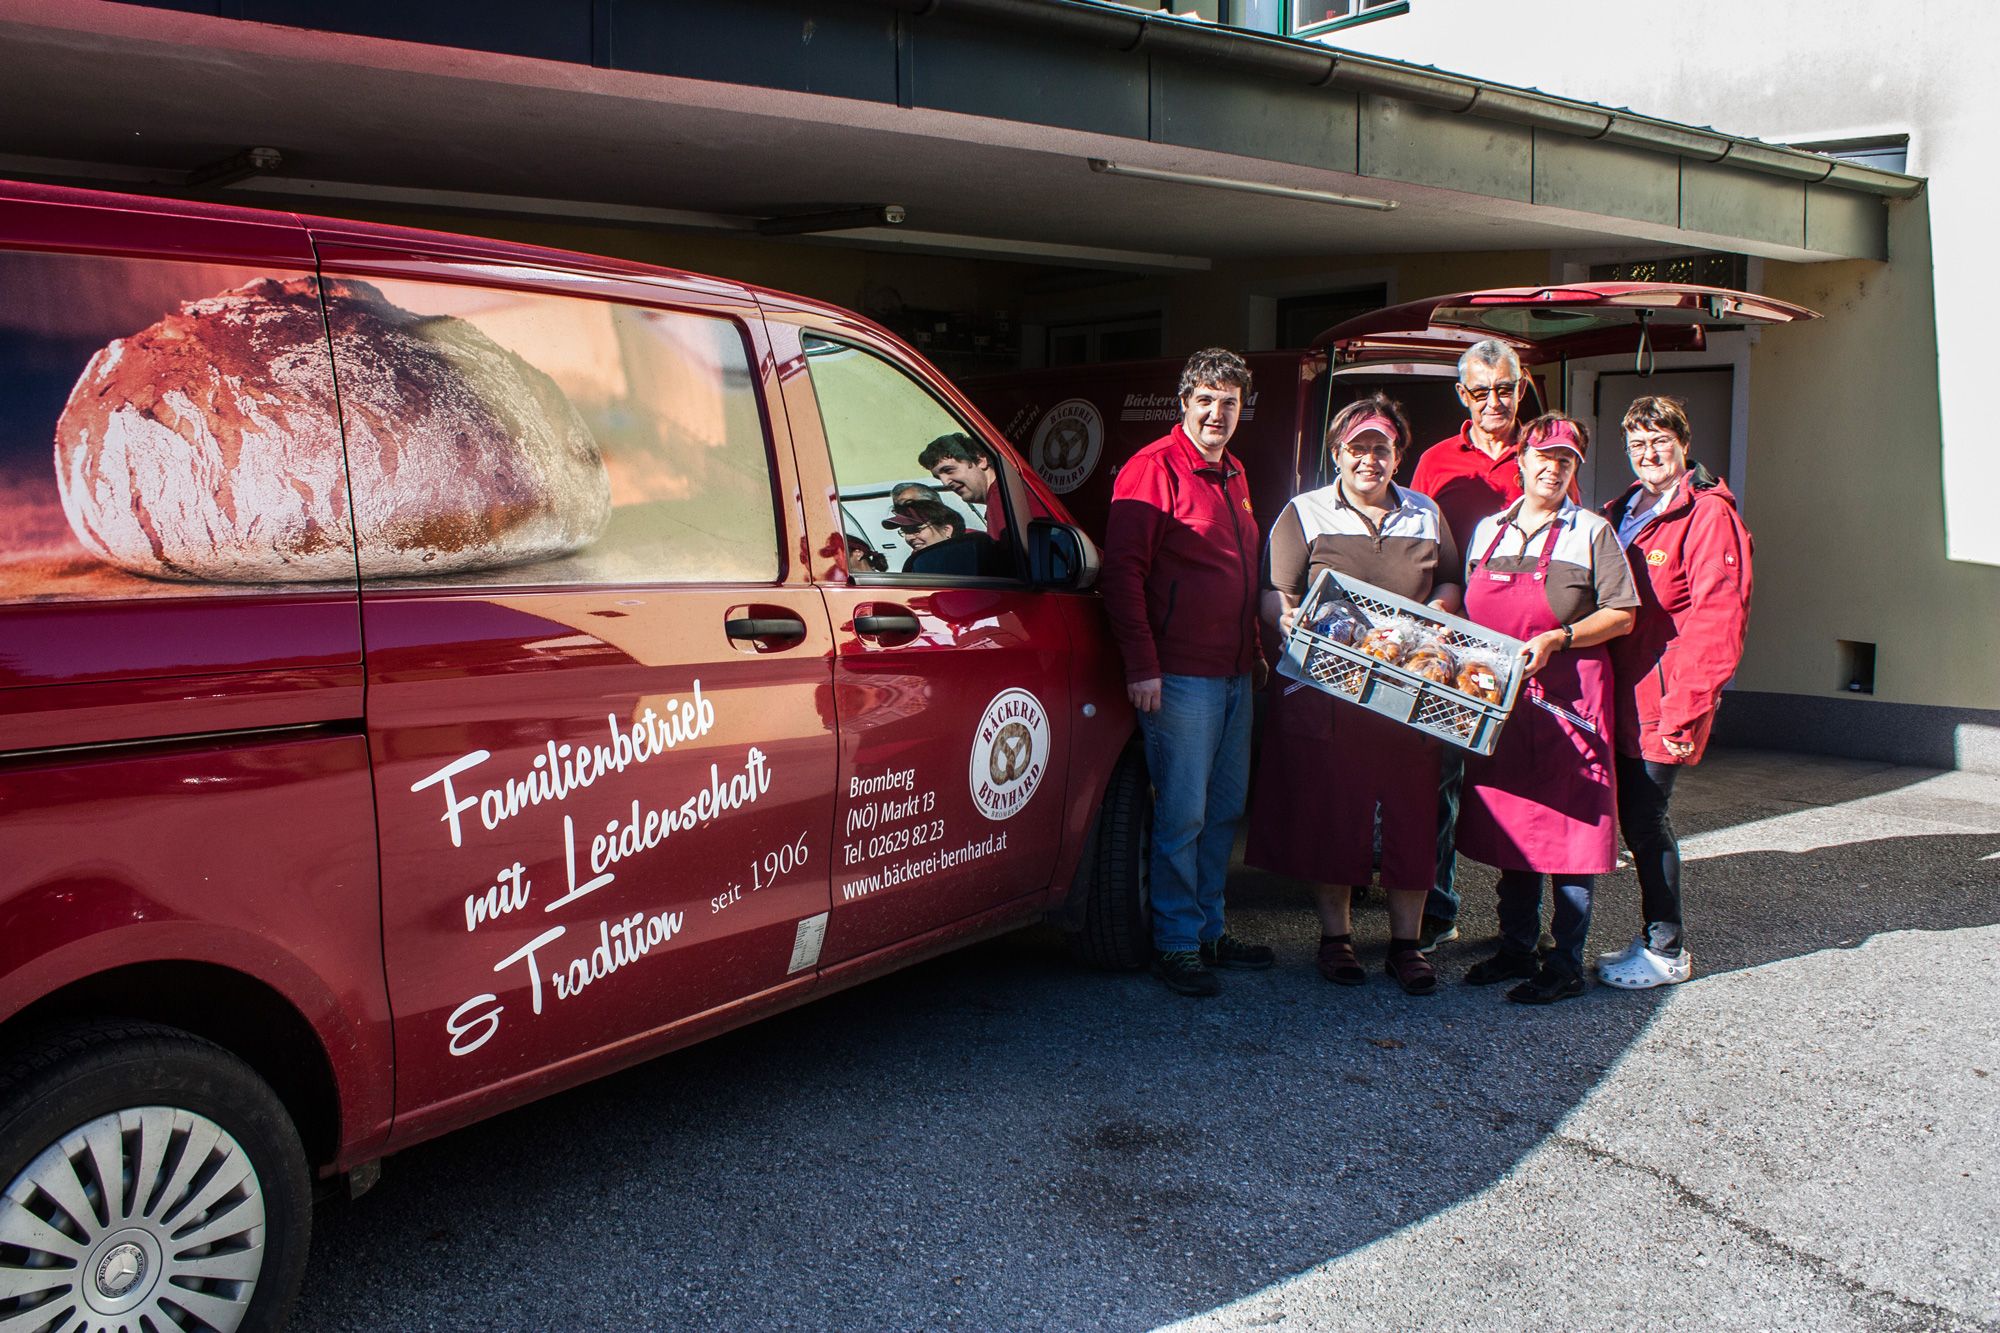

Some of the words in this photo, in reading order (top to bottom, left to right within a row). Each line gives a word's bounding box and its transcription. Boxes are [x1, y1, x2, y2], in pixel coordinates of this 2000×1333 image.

[1050, 406, 1094, 424] BÄCKEREI
[1123, 393, 1180, 408] Bäckere
[1037, 464, 1085, 487] BERNHARD
[983, 700, 1041, 744] BÄCKEREI
[410, 678, 715, 848] Familienbetrieb
[849, 768, 916, 799] Bromberg
[978, 763, 1040, 810] BERNHARD
[846, 802, 878, 837] (NÖ)
[880, 791, 919, 824] Markt
[922, 791, 936, 812] 13
[465, 862, 531, 932] mit
[544, 747, 772, 912] Leidenschaft
[843, 840, 865, 866] Tel.
[868, 828, 910, 858] 02629
[912, 823, 928, 846] 82
[929, 819, 945, 842] 23
[711, 881, 742, 914] seit
[750, 831, 810, 892] 1906
[842, 830, 1008, 900] www.bäckerei-bernhard.at
[446, 993, 505, 1057] &
[493, 911, 684, 1016] Tradition
